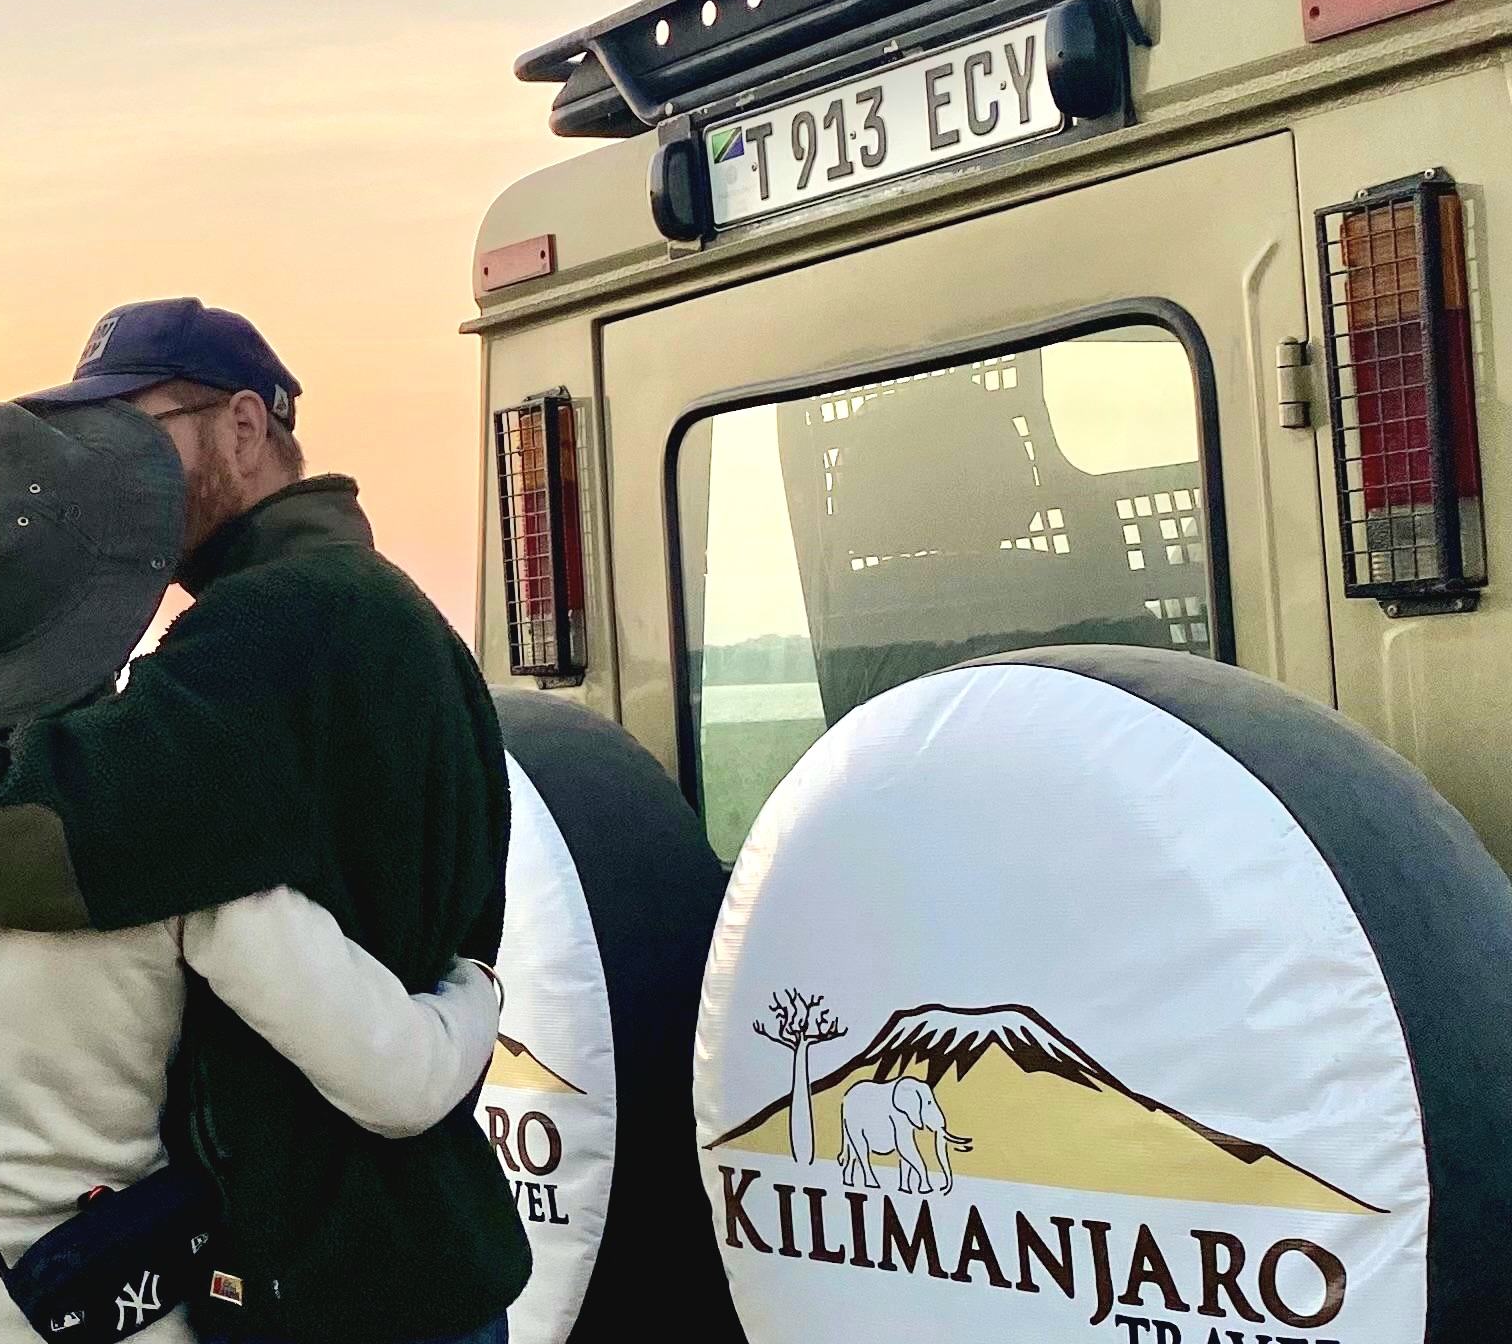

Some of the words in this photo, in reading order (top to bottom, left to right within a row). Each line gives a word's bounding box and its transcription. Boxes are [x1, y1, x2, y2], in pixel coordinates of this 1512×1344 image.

[745, 121, 773, 201] T
[791, 85, 888, 190] 913
[924, 35, 1036, 151] ECY
[718, 1164, 1347, 1329] KILIMANJARO
